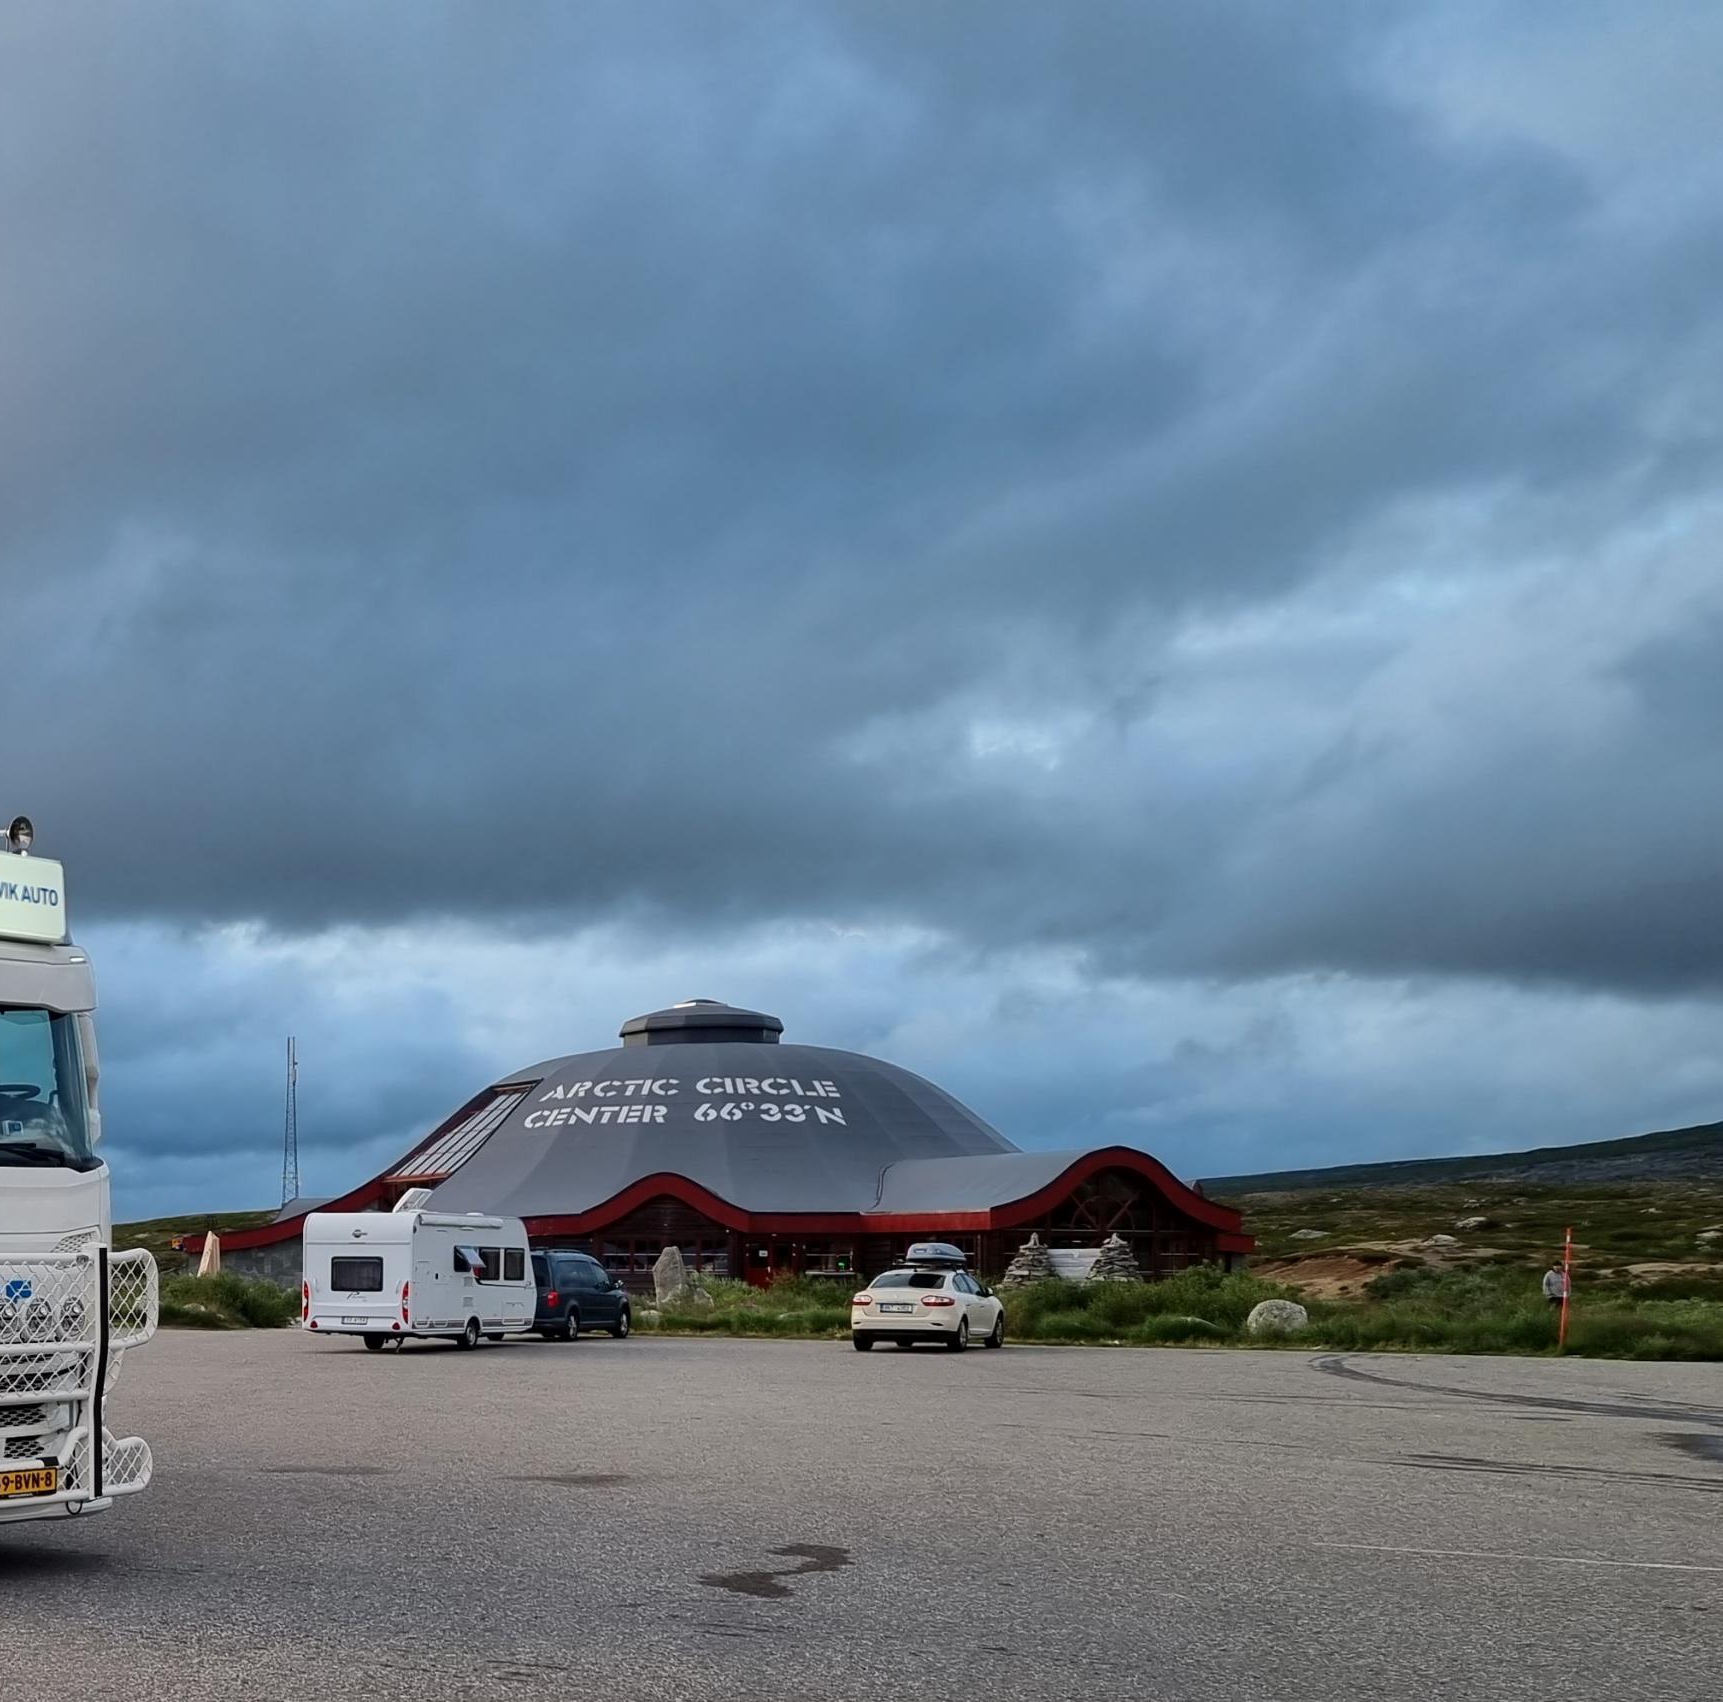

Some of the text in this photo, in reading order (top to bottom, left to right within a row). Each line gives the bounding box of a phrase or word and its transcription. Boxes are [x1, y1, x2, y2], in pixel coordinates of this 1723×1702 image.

[21, 887, 59, 907] AUTO
[539, 1077, 841, 1102] ARCTIC CIRCLE
[524, 1105, 668, 1128] CENTER
